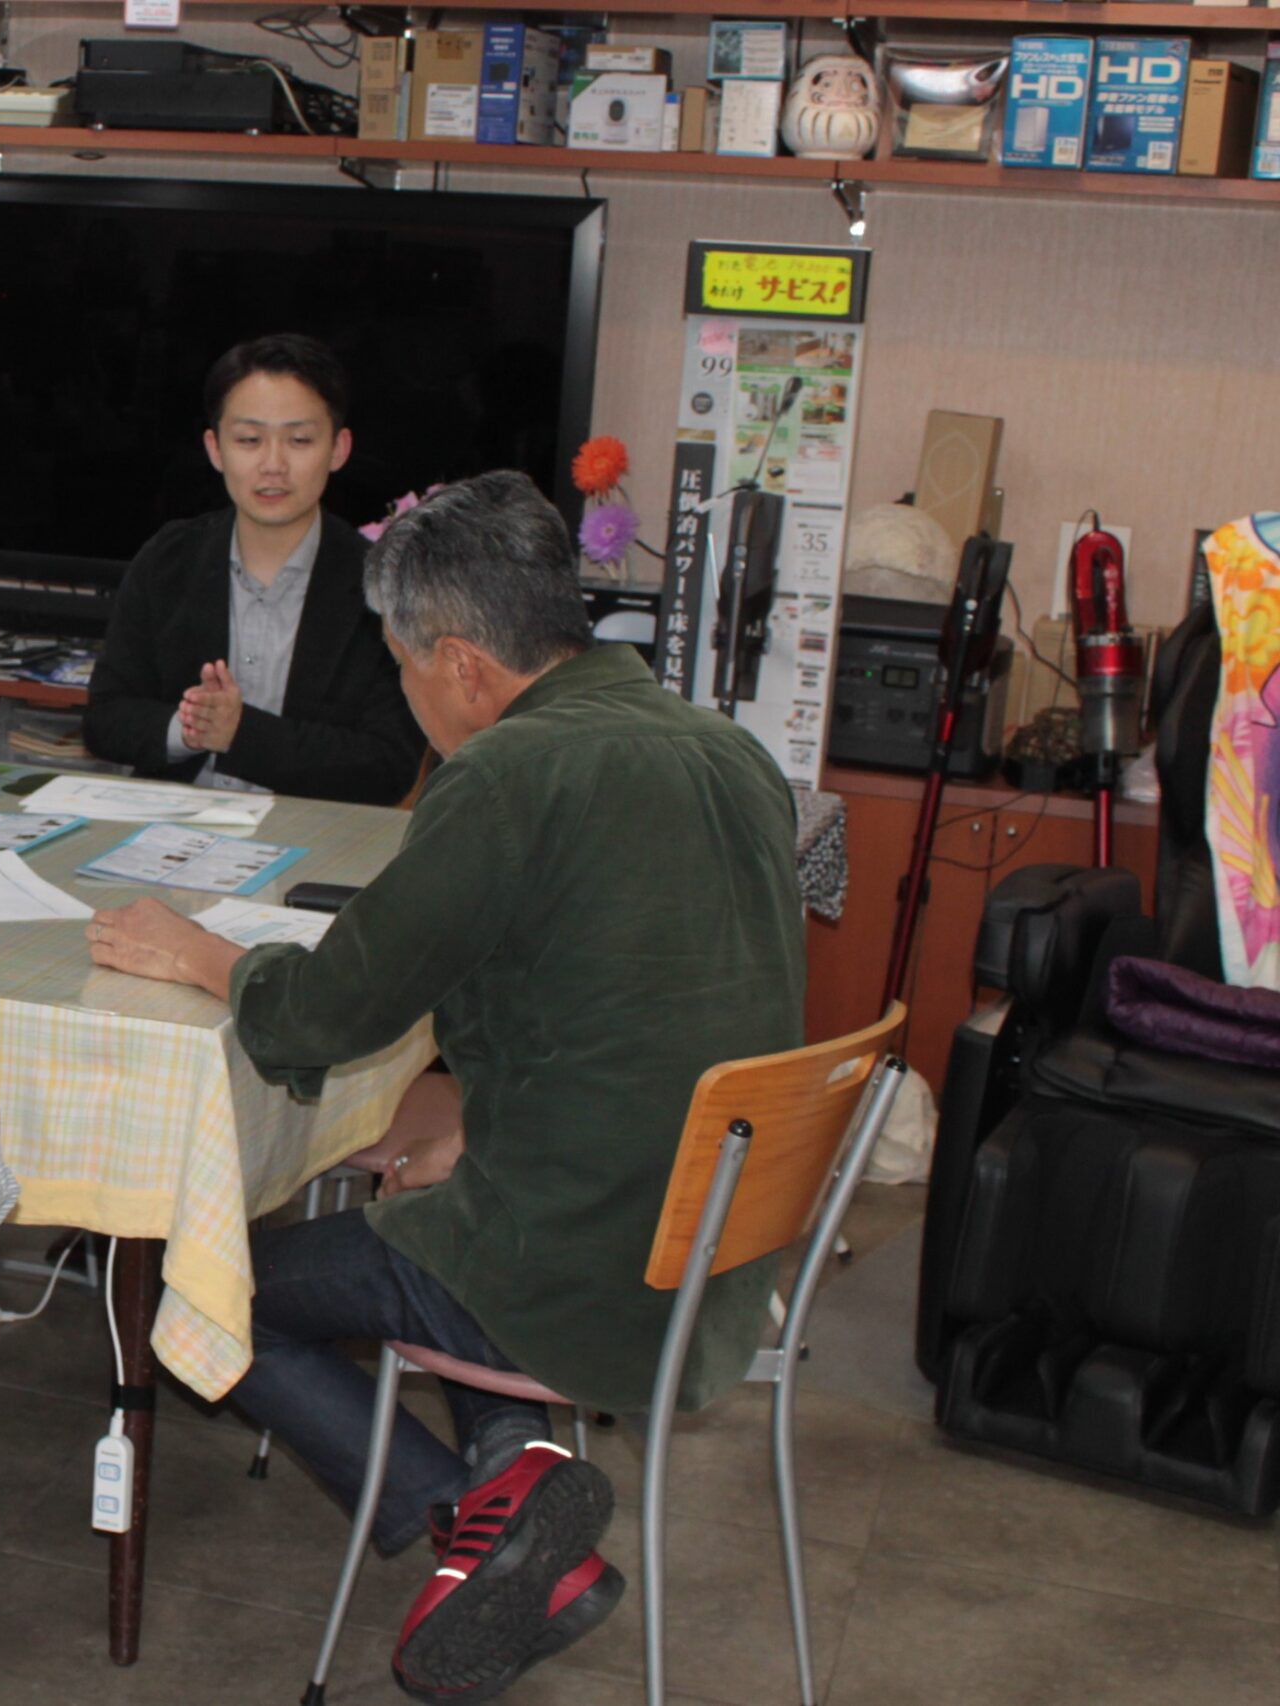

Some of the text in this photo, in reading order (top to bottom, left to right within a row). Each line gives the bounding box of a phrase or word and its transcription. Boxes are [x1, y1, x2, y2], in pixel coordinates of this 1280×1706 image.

[1097, 56, 1181, 85] HD
[1011, 74, 1084, 100] HD
[800, 532, 828, 552] 35
